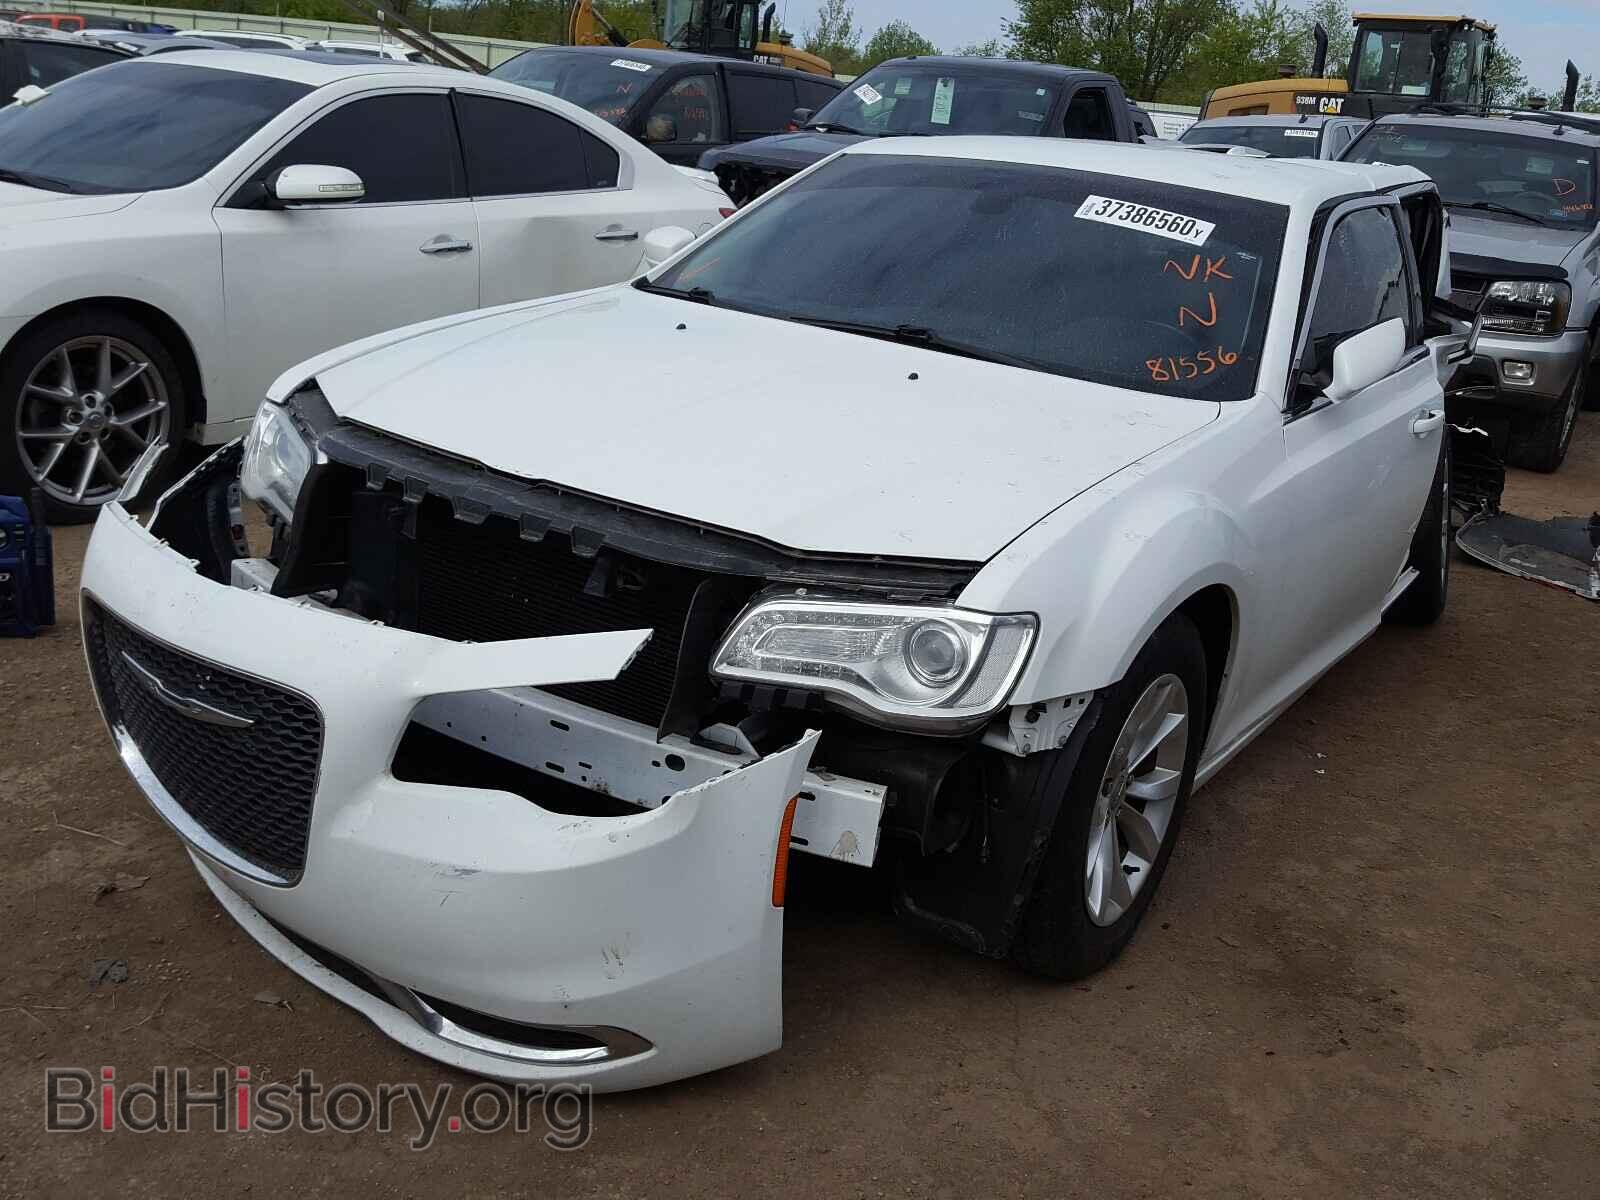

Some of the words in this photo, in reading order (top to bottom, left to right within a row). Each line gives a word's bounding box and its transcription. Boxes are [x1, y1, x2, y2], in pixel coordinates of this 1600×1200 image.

[753, 54, 769, 65] CAT
[1319, 97, 1345, 114] CAT
[1146, 345, 1238, 382] 81556
